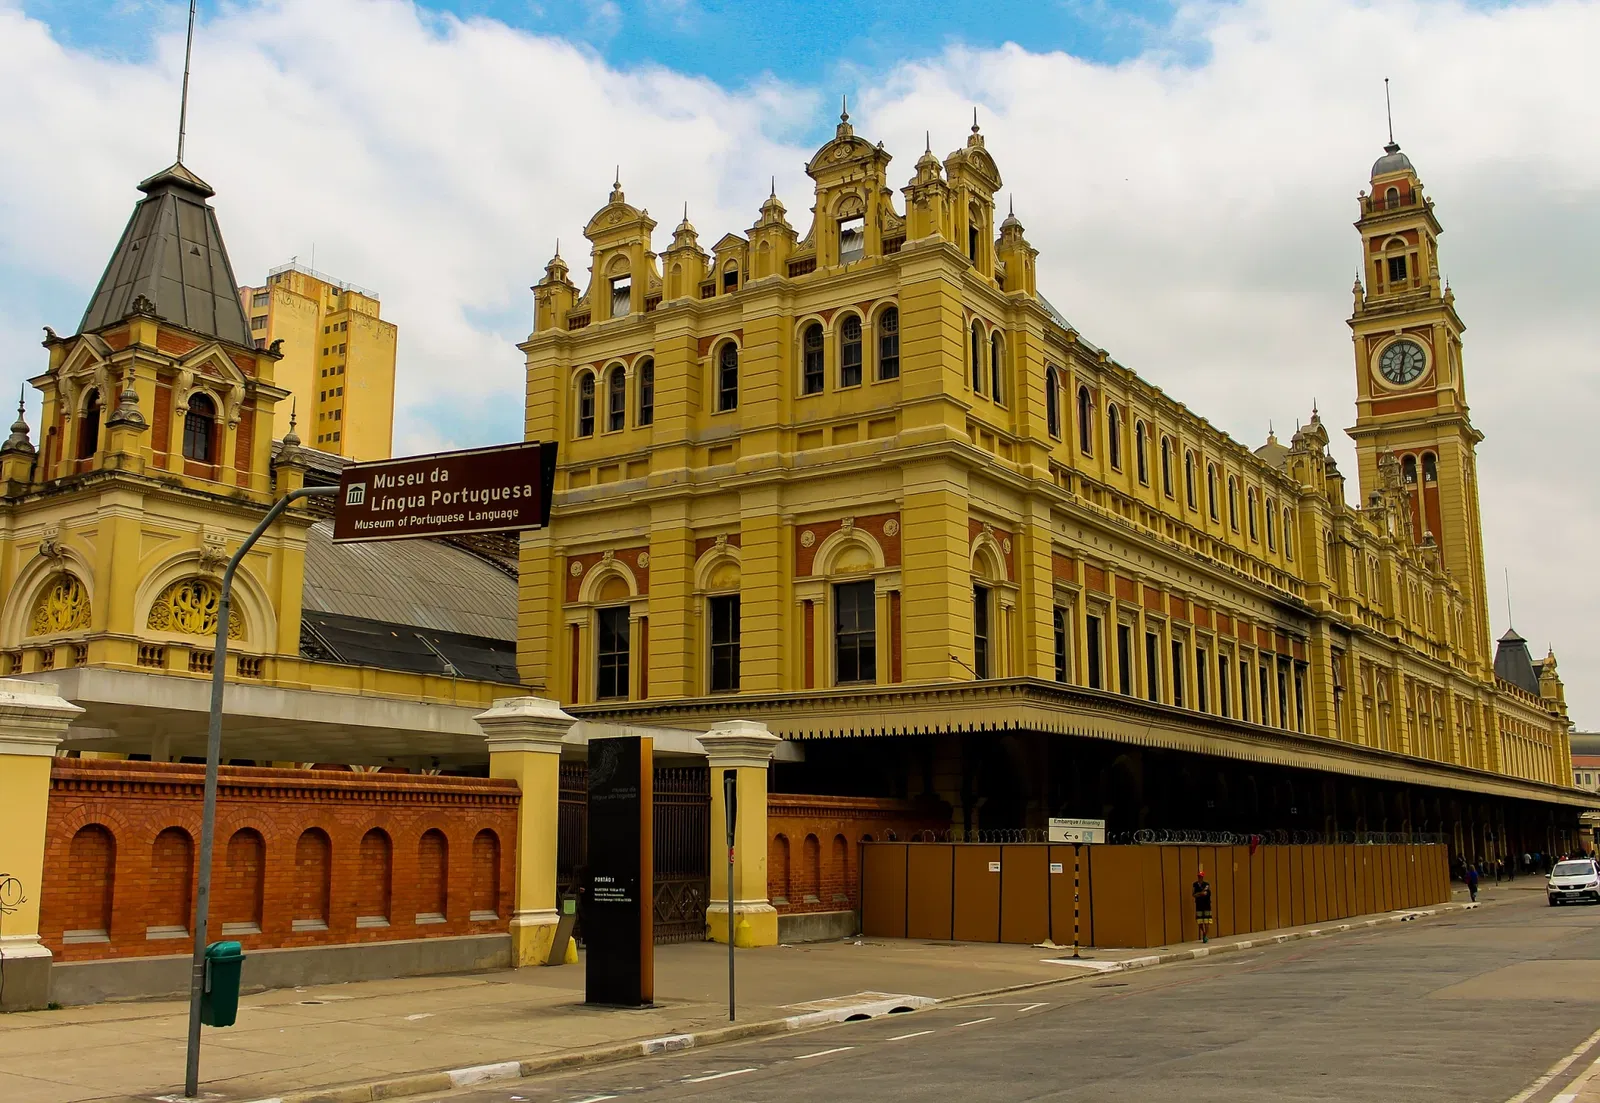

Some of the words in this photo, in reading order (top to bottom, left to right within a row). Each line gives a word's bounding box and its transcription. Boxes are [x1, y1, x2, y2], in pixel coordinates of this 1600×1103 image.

[373, 471, 424, 489] Museu
[430, 467, 449, 483] da
[371, 493, 425, 512] Língua
[431, 484, 532, 506] Portuguesa
[354, 518, 394, 530] Museum
[398, 515, 408, 527] of
[410, 512, 465, 526] Portuguese
[468, 508, 519, 521] Language
